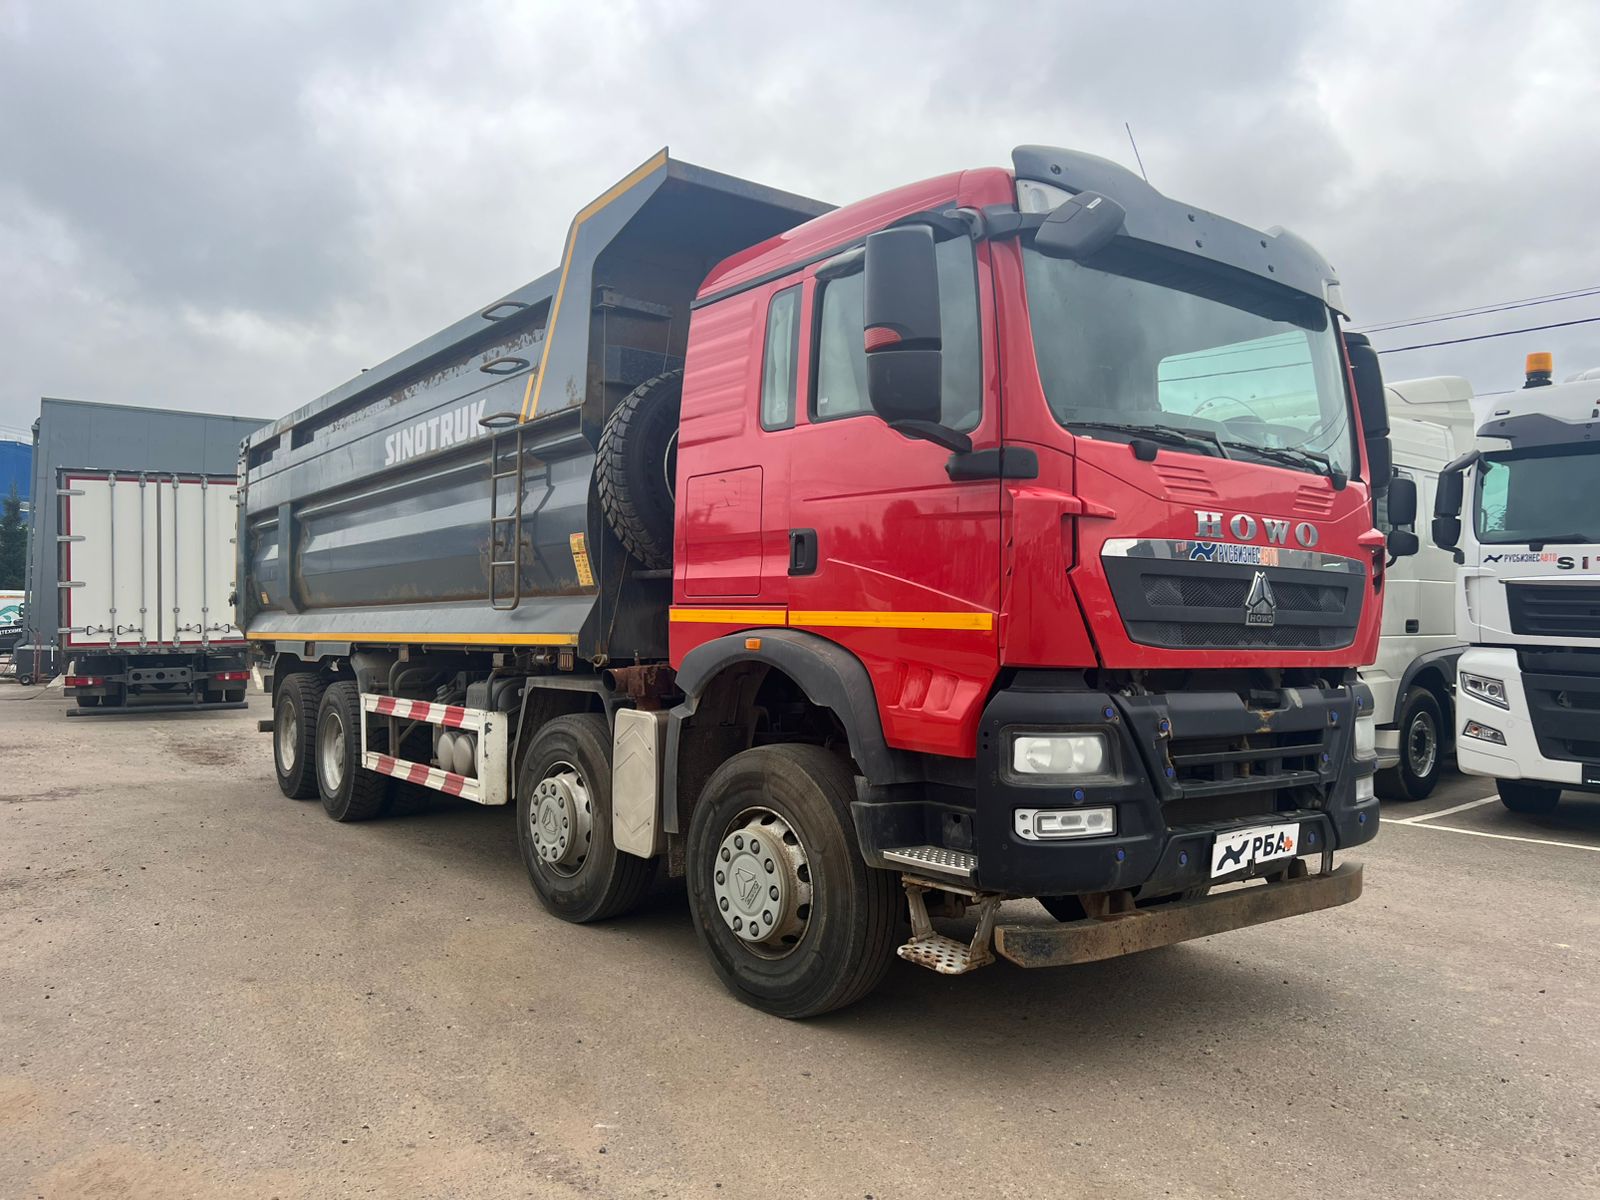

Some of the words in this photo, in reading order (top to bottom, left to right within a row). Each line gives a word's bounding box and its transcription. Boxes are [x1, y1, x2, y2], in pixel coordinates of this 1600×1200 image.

[384, 398, 487, 466] SINOTRUK
[1194, 510, 1319, 547] HOWO
[1557, 556, 1600, 570] SI
[1249, 614, 1273, 623] HOWO
